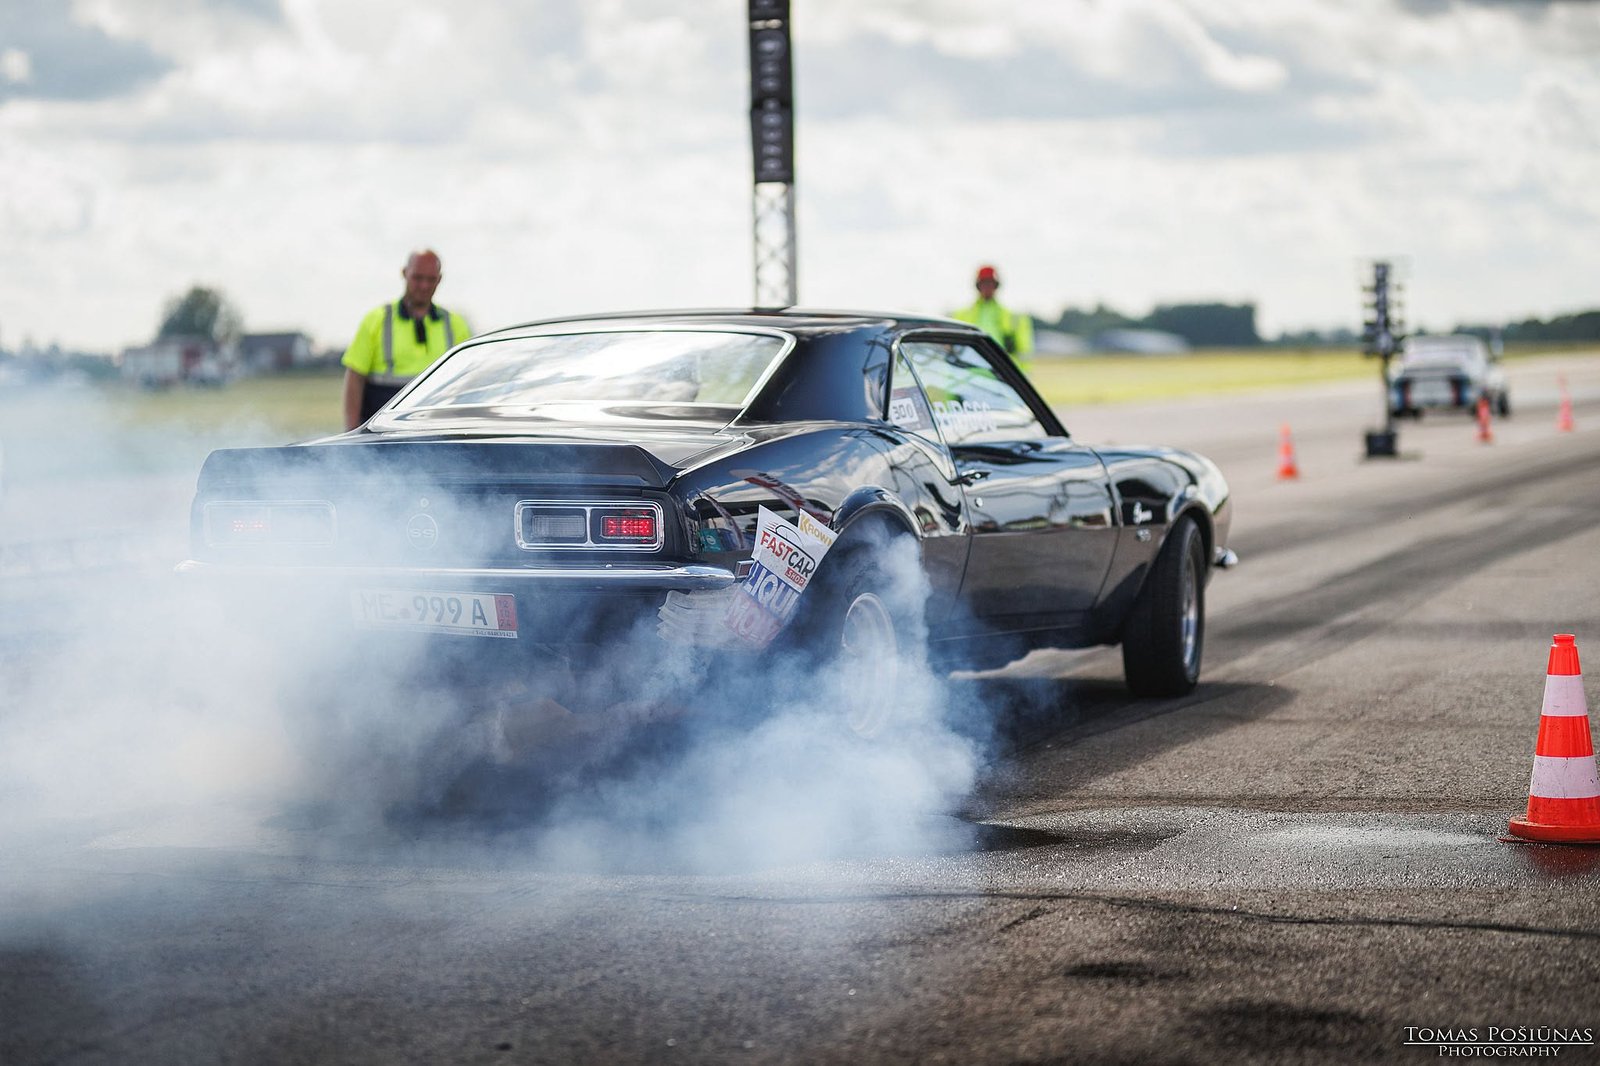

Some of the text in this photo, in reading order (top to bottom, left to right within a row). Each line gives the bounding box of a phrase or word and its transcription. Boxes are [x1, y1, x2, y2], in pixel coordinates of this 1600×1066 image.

[786, 569, 805, 587] SHOP
[412, 595, 463, 624] 999
[471, 598, 488, 626] A
